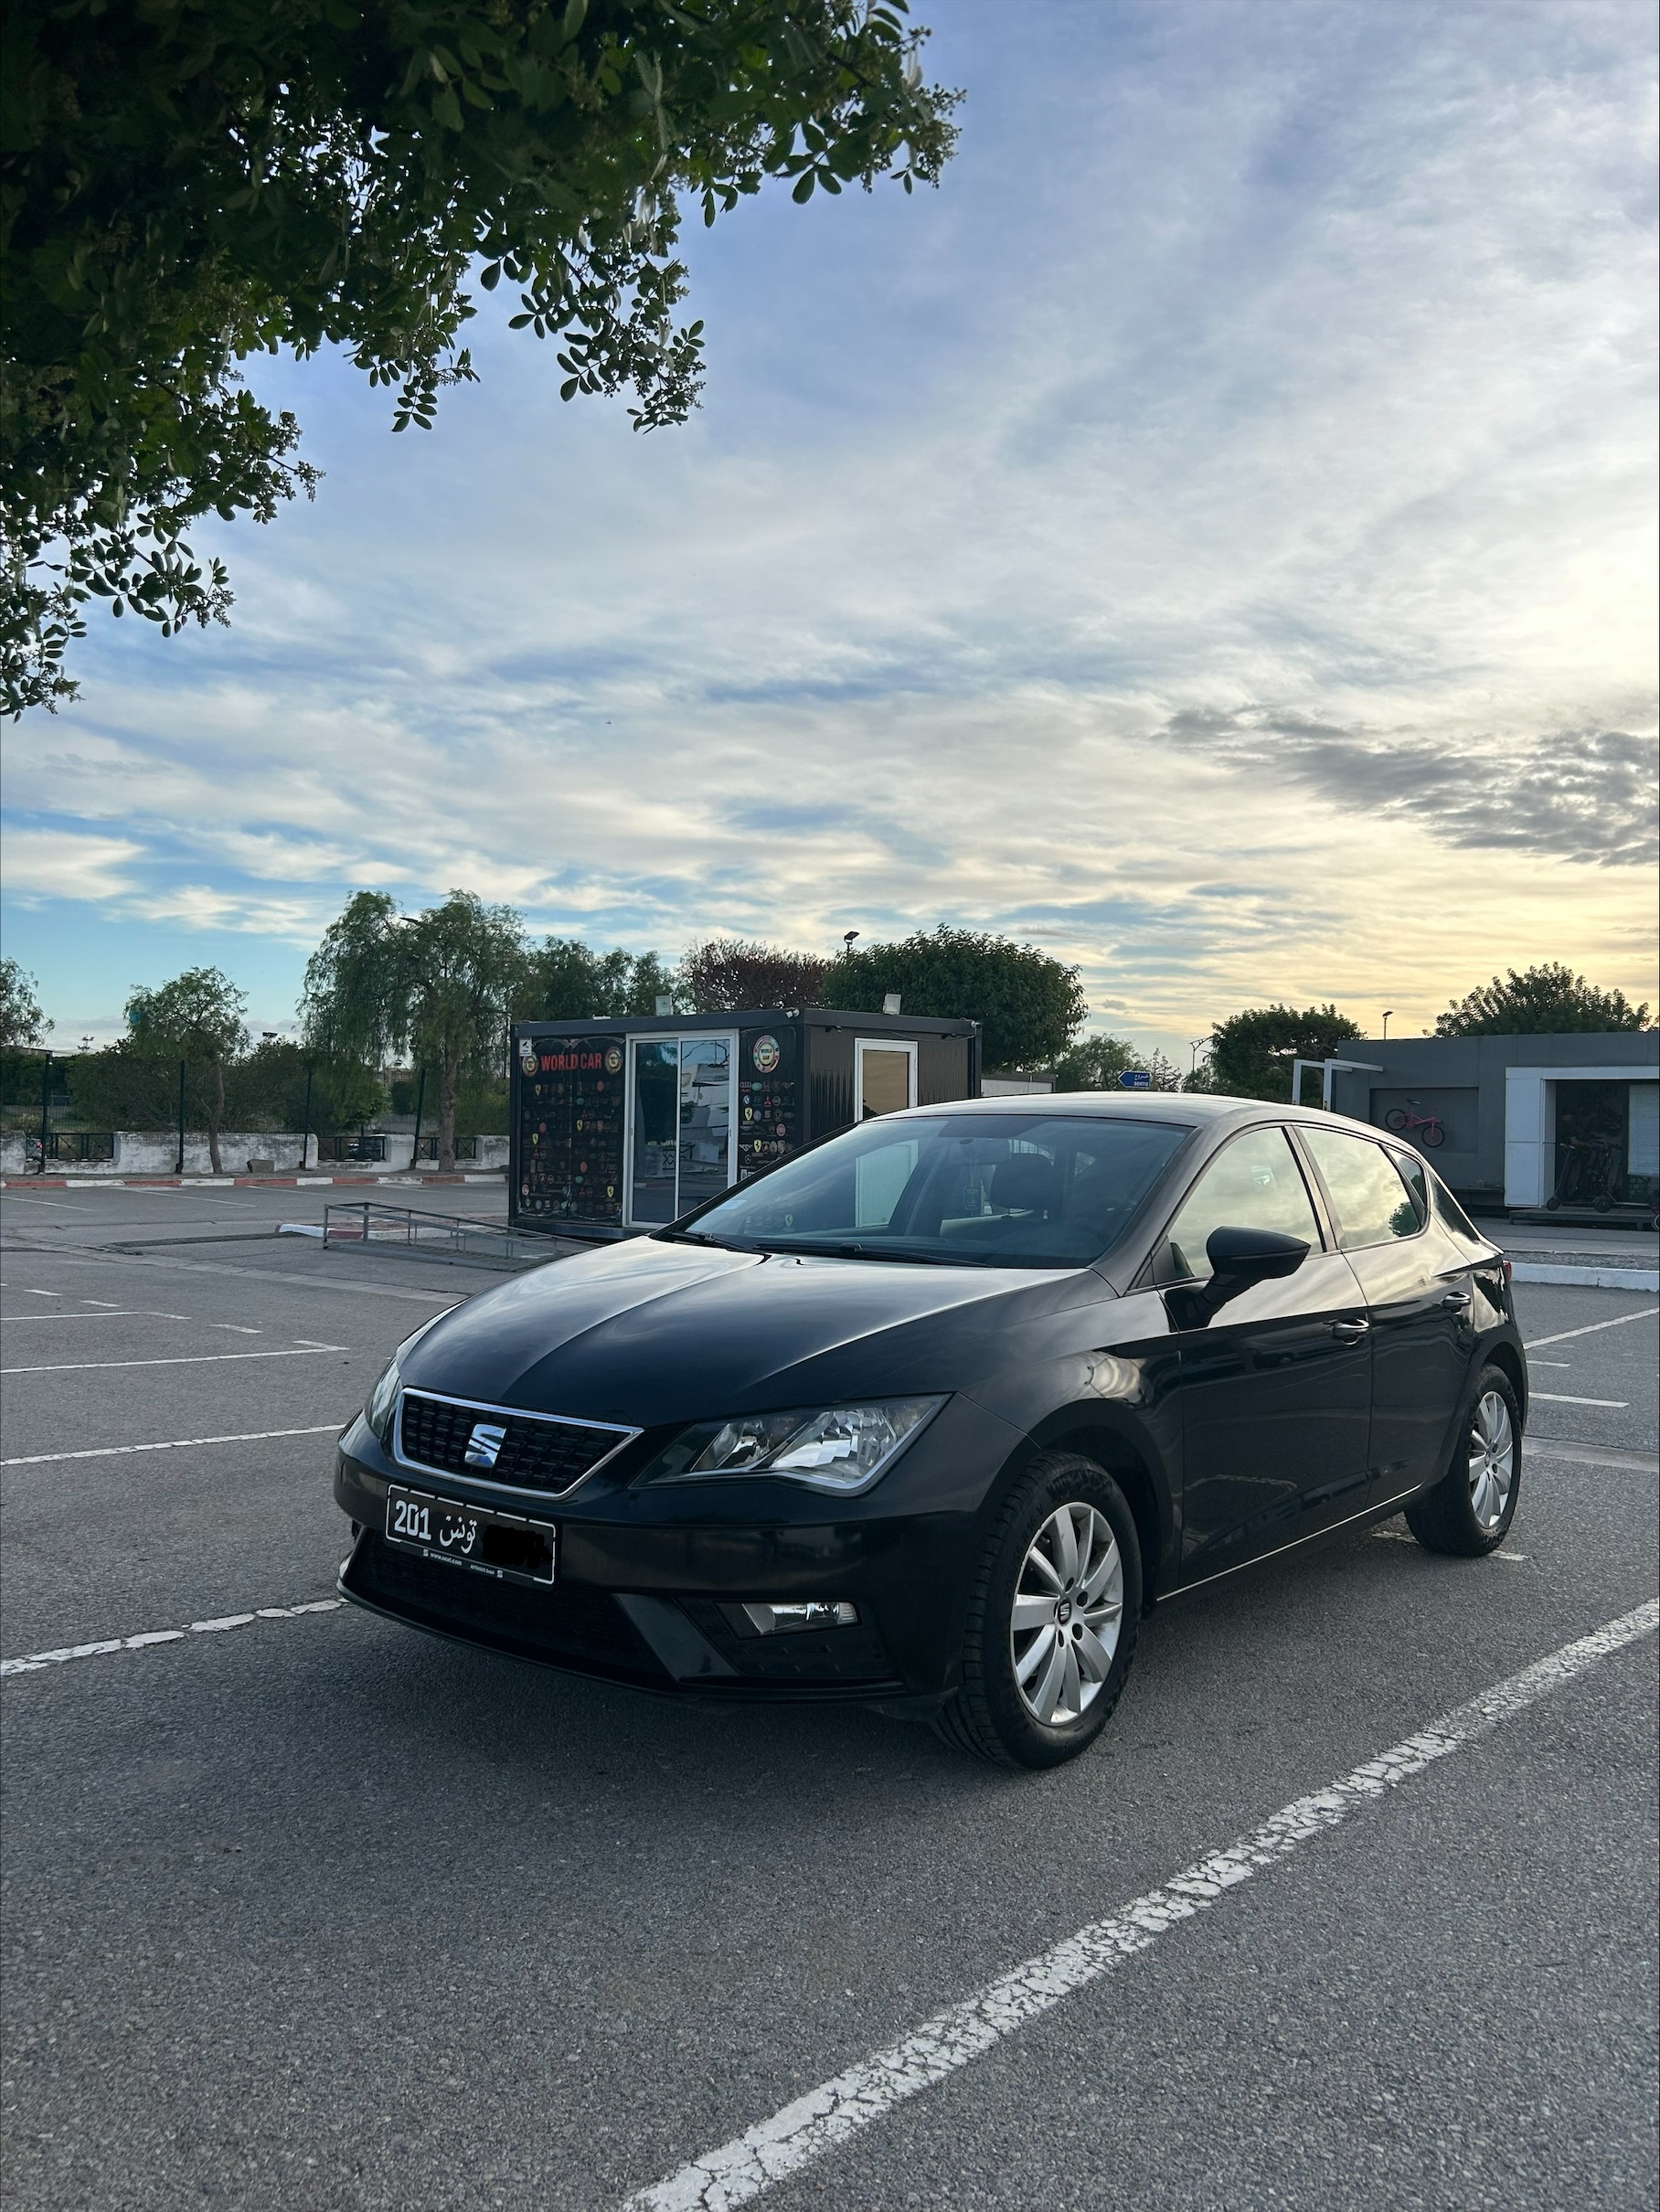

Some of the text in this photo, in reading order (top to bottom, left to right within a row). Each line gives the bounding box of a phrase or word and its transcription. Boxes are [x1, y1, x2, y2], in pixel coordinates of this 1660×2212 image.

[541, 1053, 579, 1072] WORLD
[580, 1052, 601, 1069] CAR
[394, 1500, 431, 1541] 201
[440, 1515, 477, 1554] تونس
